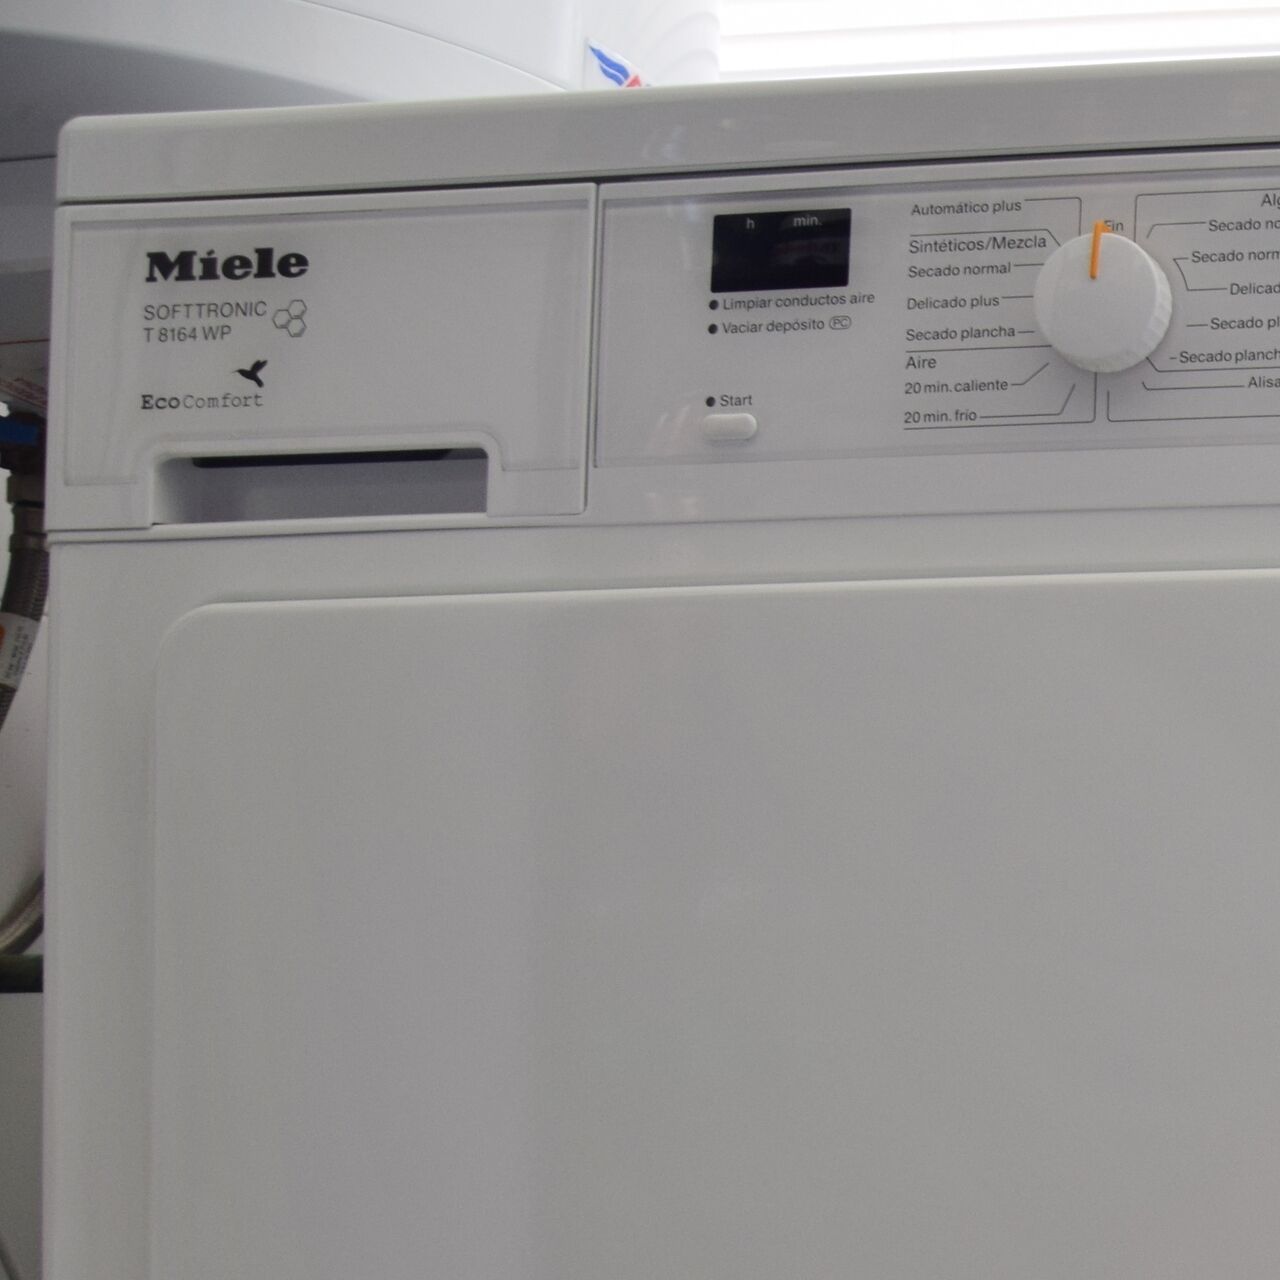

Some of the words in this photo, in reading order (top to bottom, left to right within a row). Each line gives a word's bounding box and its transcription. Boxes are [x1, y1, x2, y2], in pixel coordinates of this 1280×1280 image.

[911, 201, 989, 216] Automático
[992, 200, 1022, 215] plus
[1209, 218, 1262, 232] Secado
[1191, 250, 1244, 263] Secado
[146, 248, 309, 282] Miele
[908, 262, 960, 278] Secado
[963, 262, 1011, 275] normal
[722, 297, 772, 312] Limpiar
[775, 294, 846, 308] conductos
[850, 292, 875, 304] aire
[907, 296, 967, 310] Delicado
[971, 294, 1000, 309] plus
[143, 301, 268, 321] SOFTTRONIC
[722, 321, 762, 334] Vaciar
[766, 318, 825, 333] depósito
[1210, 317, 1263, 330] Secado
[143, 328, 156, 342] T
[158, 327, 198, 342] 8164
[202, 325, 232, 341] WP
[906, 328, 958, 341] Secado
[961, 326, 1016, 341] plancha
[905, 356, 937, 369] Aire
[1180, 350, 1232, 364] Secado
[904, 382, 921, 394] 20
[954, 379, 1008, 392] caliente
[720, 394, 753, 407] Start
[904, 411, 921, 423] 20
